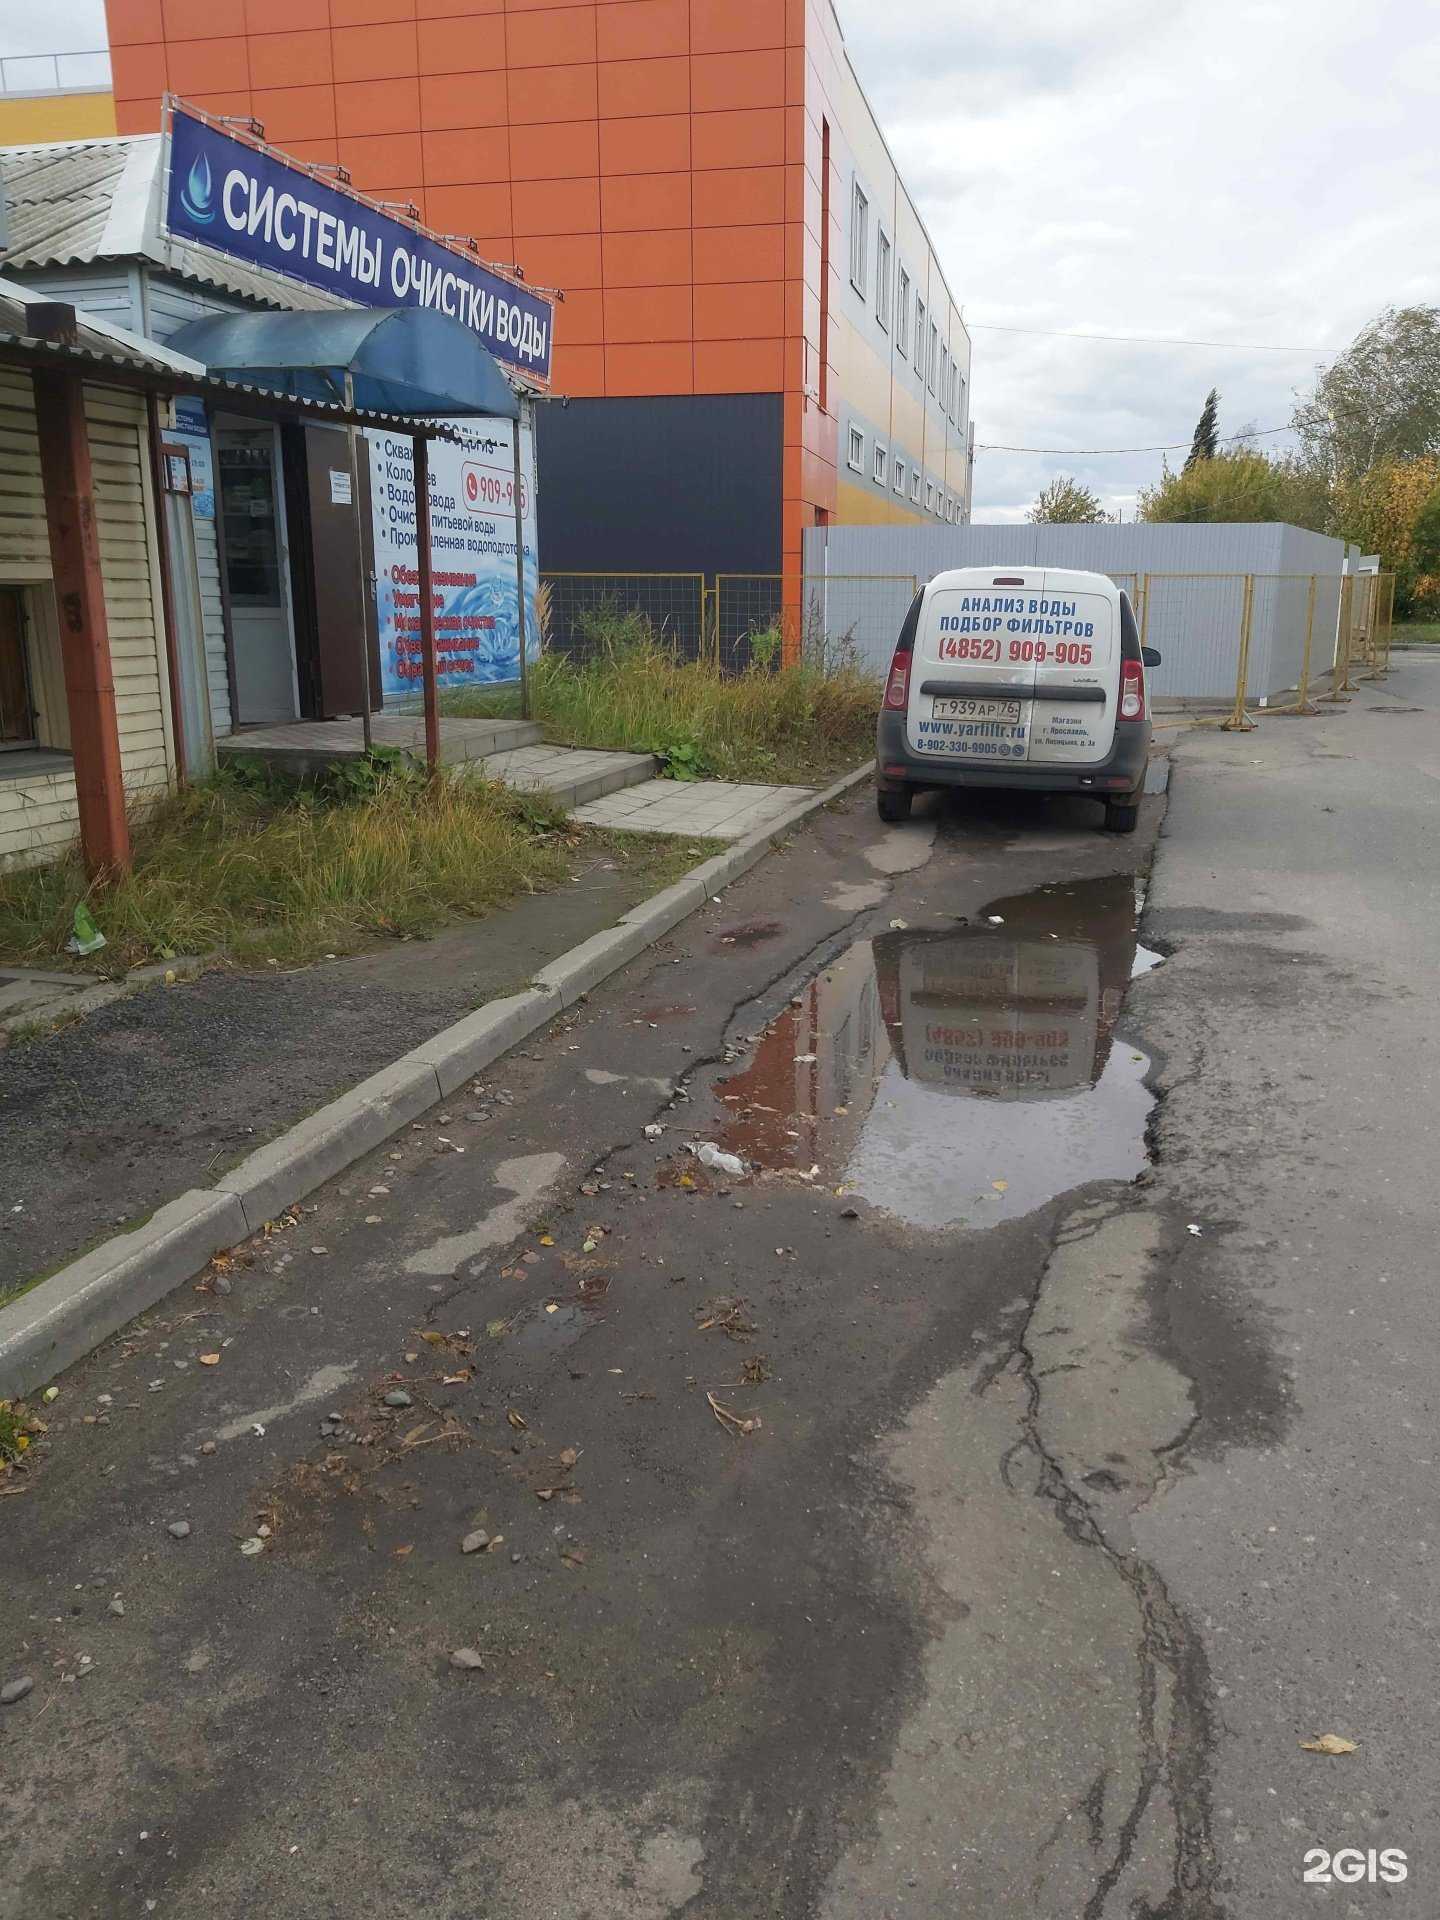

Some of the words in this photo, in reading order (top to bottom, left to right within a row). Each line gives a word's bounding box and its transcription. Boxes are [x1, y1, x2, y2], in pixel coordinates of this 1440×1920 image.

[223, 169, 382, 287] СИСТЕМЫ
[391, 247, 495, 337] ОЧИСТКИ
[497, 299, 546, 362] ВОДЫ
[388, 484, 456, 512] Водоовода
[480, 476, 525, 509] 909-95
[432, 514, 473, 532] питьевой
[475, 521, 496, 535] воды
[961, 598, 1024, 613] АНАЛИЗ
[1029, 600, 1076, 617] ВОДЫ
[940, 616, 1002, 633] ПОДБОР
[1007, 618, 1094, 637] ФИЛЬТРОВ
[939, 638, 1002, 662] (4852)
[1008, 640, 1092, 665] 909-905
[917, 738, 997, 754] 8-902-330-9905
